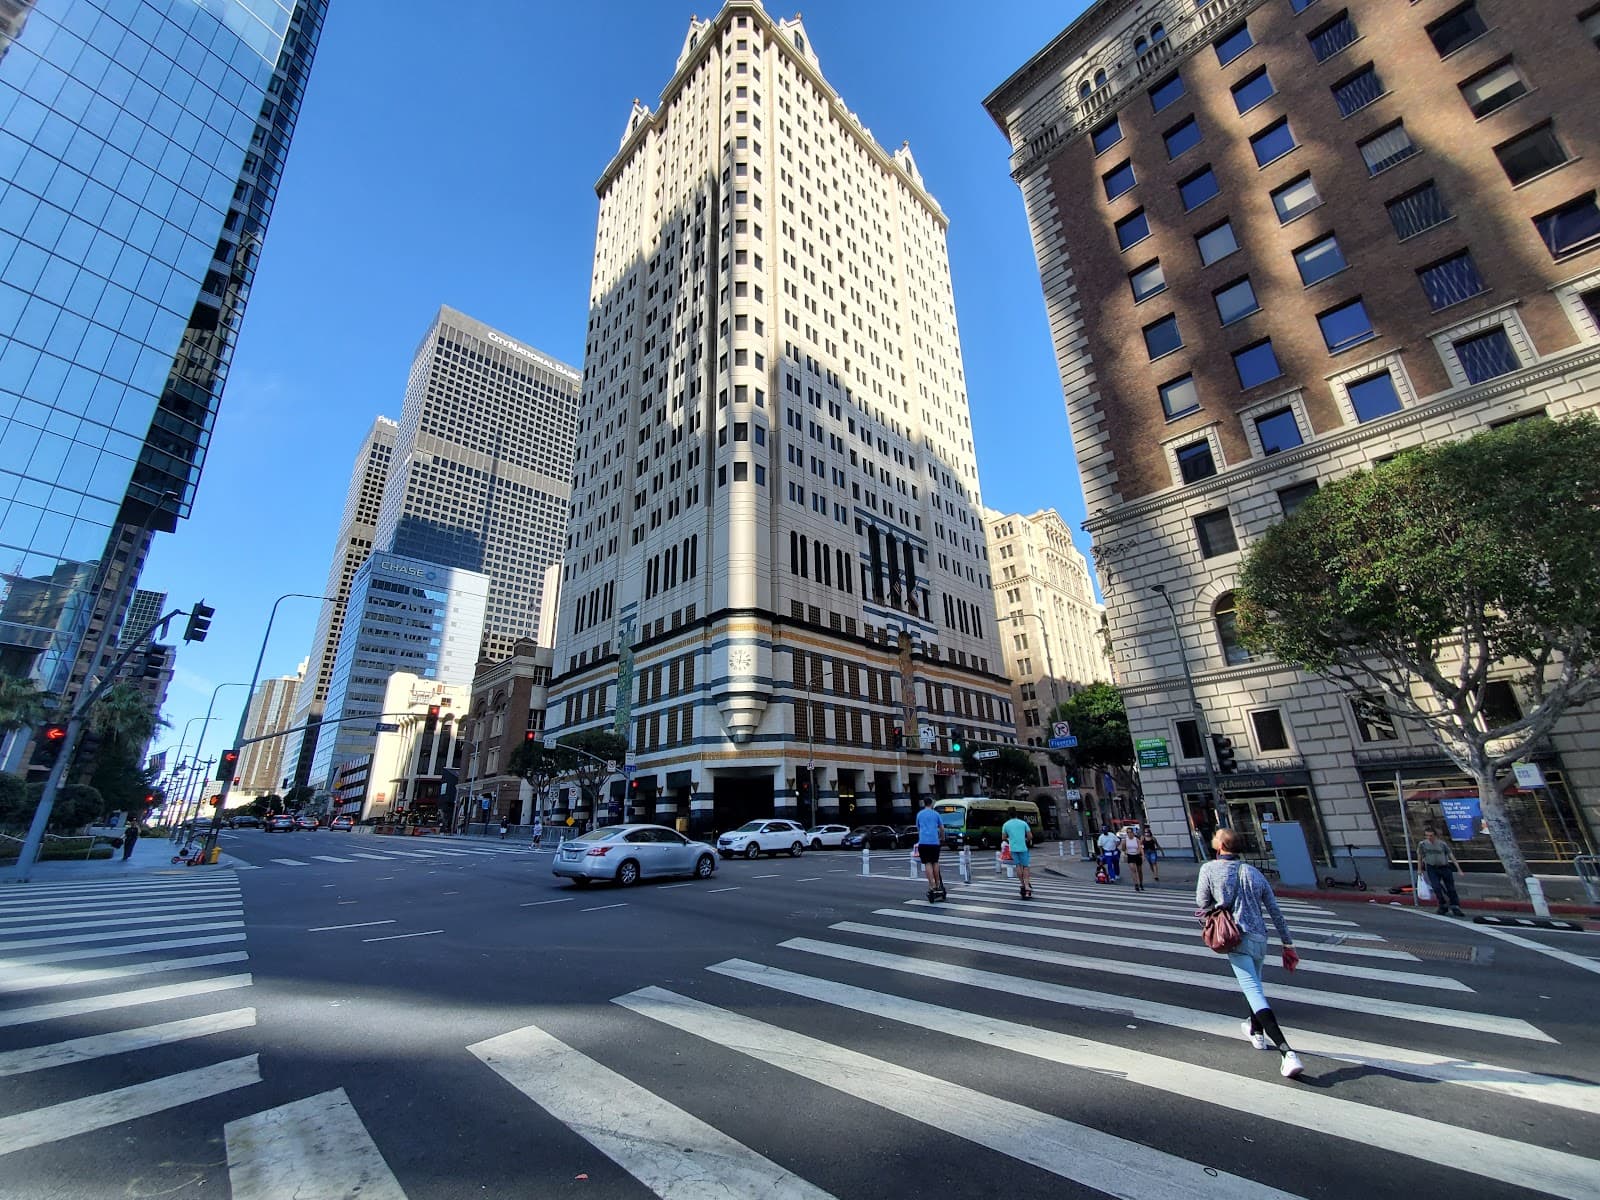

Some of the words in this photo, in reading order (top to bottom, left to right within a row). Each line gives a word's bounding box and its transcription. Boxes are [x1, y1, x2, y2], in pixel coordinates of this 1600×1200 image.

[488, 332, 509, 346] CITY
[509, 342, 555, 369] NATIONAL
[556, 364, 580, 381] BANK
[381, 561, 424, 577] CHASE
[1051, 738, 1075, 748] Figueroa
[1219, 780, 1228, 789] of
[1230, 780, 1266, 788] America
